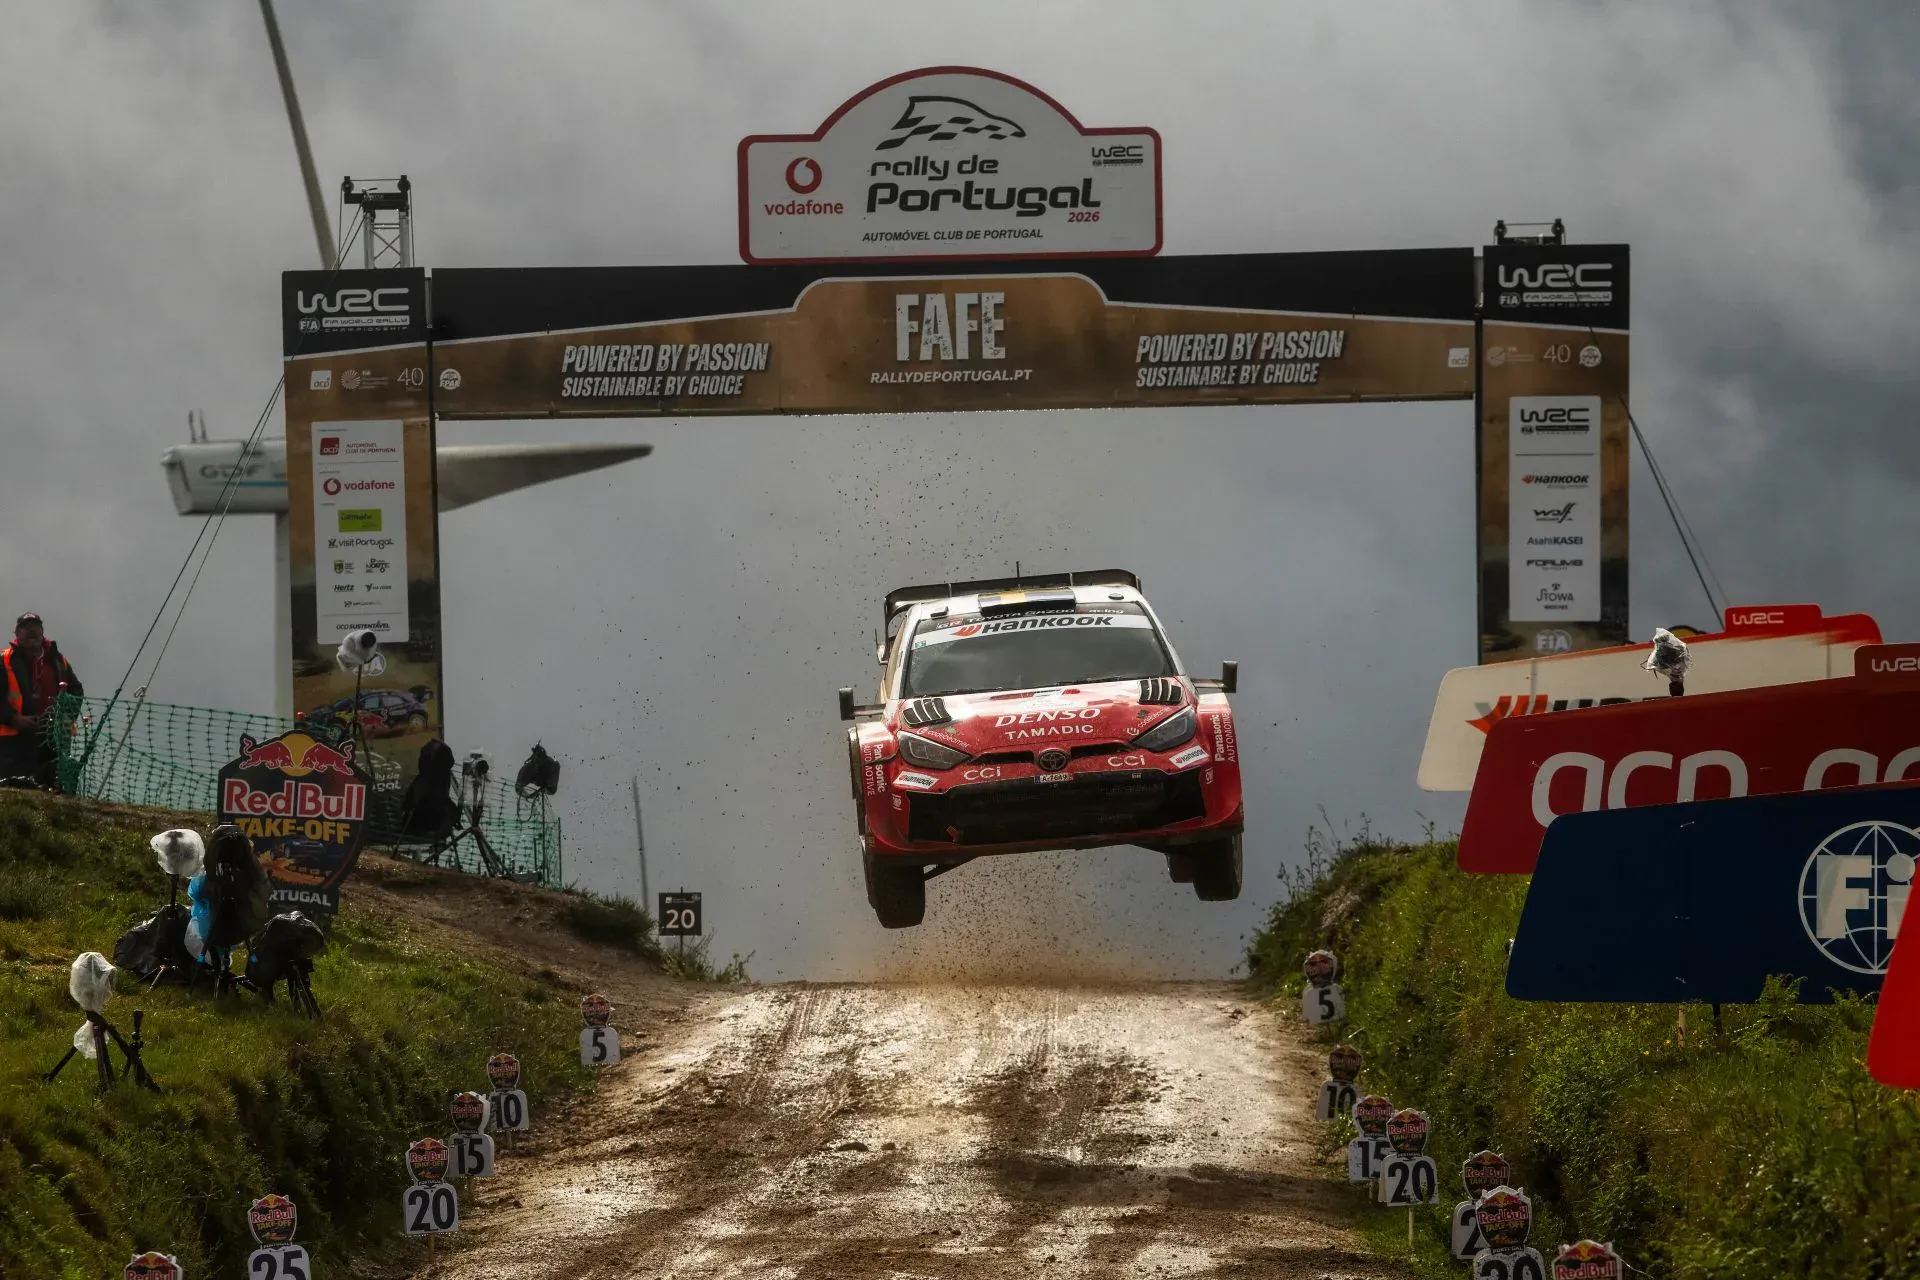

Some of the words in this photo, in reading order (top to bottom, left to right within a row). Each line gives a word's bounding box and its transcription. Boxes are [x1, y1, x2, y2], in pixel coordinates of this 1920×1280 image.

[1091, 145, 1144, 158] WRC
[870, 155, 950, 181] rally
[957, 154, 999, 175] de
[866, 178, 1101, 217] Portugal
[764, 199, 844, 216] vodafone
[1067, 211, 1101, 223] 2026
[862, 229, 931, 242] AUTOMÓVEL
[933, 229, 963, 241] CLUB
[965, 229, 981, 240] DE
[983, 228, 1044, 239] PORTUGAL
[1498, 263, 1613, 288] WRC
[297, 288, 410, 313] WRC
[1499, 294, 1520, 305] FIA
[300, 320, 320, 331] FIA
[896, 291, 1006, 361] FAFE
[1135, 333, 1228, 363] POWERED
[1230, 332, 1258, 361] BY
[1259, 330, 1345, 360] PASSION
[1543, 344, 1571, 363] 40
[562, 345, 653, 373] POWERED
[656, 344, 688, 372] BY
[685, 343, 770, 371] PASSION
[397, 367, 424, 386] 40
[870, 368, 1033, 385] RALLYDEPORTUGAL.PT
[1135, 365, 1236, 387] SUSTAINABLE
[1238, 364, 1261, 385] BY
[1263, 363, 1320, 384] CHOICE
[562, 376, 663, 397] SUSTAINABLE
[664, 376, 686, 396] BY
[688, 375, 744, 395] CHOICE
[1520, 408, 1590, 423] WRC
[344, 480, 395, 490] vodafone
[339, 538, 355, 547] visit
[355, 538, 394, 550] Portugal
[334, 584, 355, 593] Hertz
[1732, 611, 1785, 625] WRC
[1537, 634, 1569, 650] FIA
[994, 708, 1101, 727] DENSO
[1005, 724, 1094, 740] TAMADIC
[1210, 713, 1225, 762] Panasonic
[224, 778, 295, 817] Red
[297, 782, 366, 821] Bull
[235, 816, 350, 845] TAKE-OFF
[268, 889, 332, 908] RTUGAL
[665, 908, 696, 929] 20
[1317, 988, 1335, 1021] 5
[592, 1031, 608, 1062] 5
[491, 1093, 522, 1129] 10
[1388, 1123, 1408, 1135] Red
[1408, 1122, 1428, 1134] Bull
[410, 1150, 429, 1162] Red
[428, 1149, 448, 1161] Bull
[454, 1137, 485, 1175] 15
[1387, 1159, 1436, 1204] 20
[1465, 1166, 1487, 1178] Red
[1487, 1166, 1508, 1178] Bull
[251, 1209, 274, 1223] Red
[274, 1206, 295, 1220] Bull
[408, 1187, 456, 1232] 20
[1479, 1209, 1504, 1225] Red
[1503, 1205, 1529, 1221] Bull
[1554, 1263, 1586, 1280] Red
[1586, 1260, 1617, 1280] Bull
